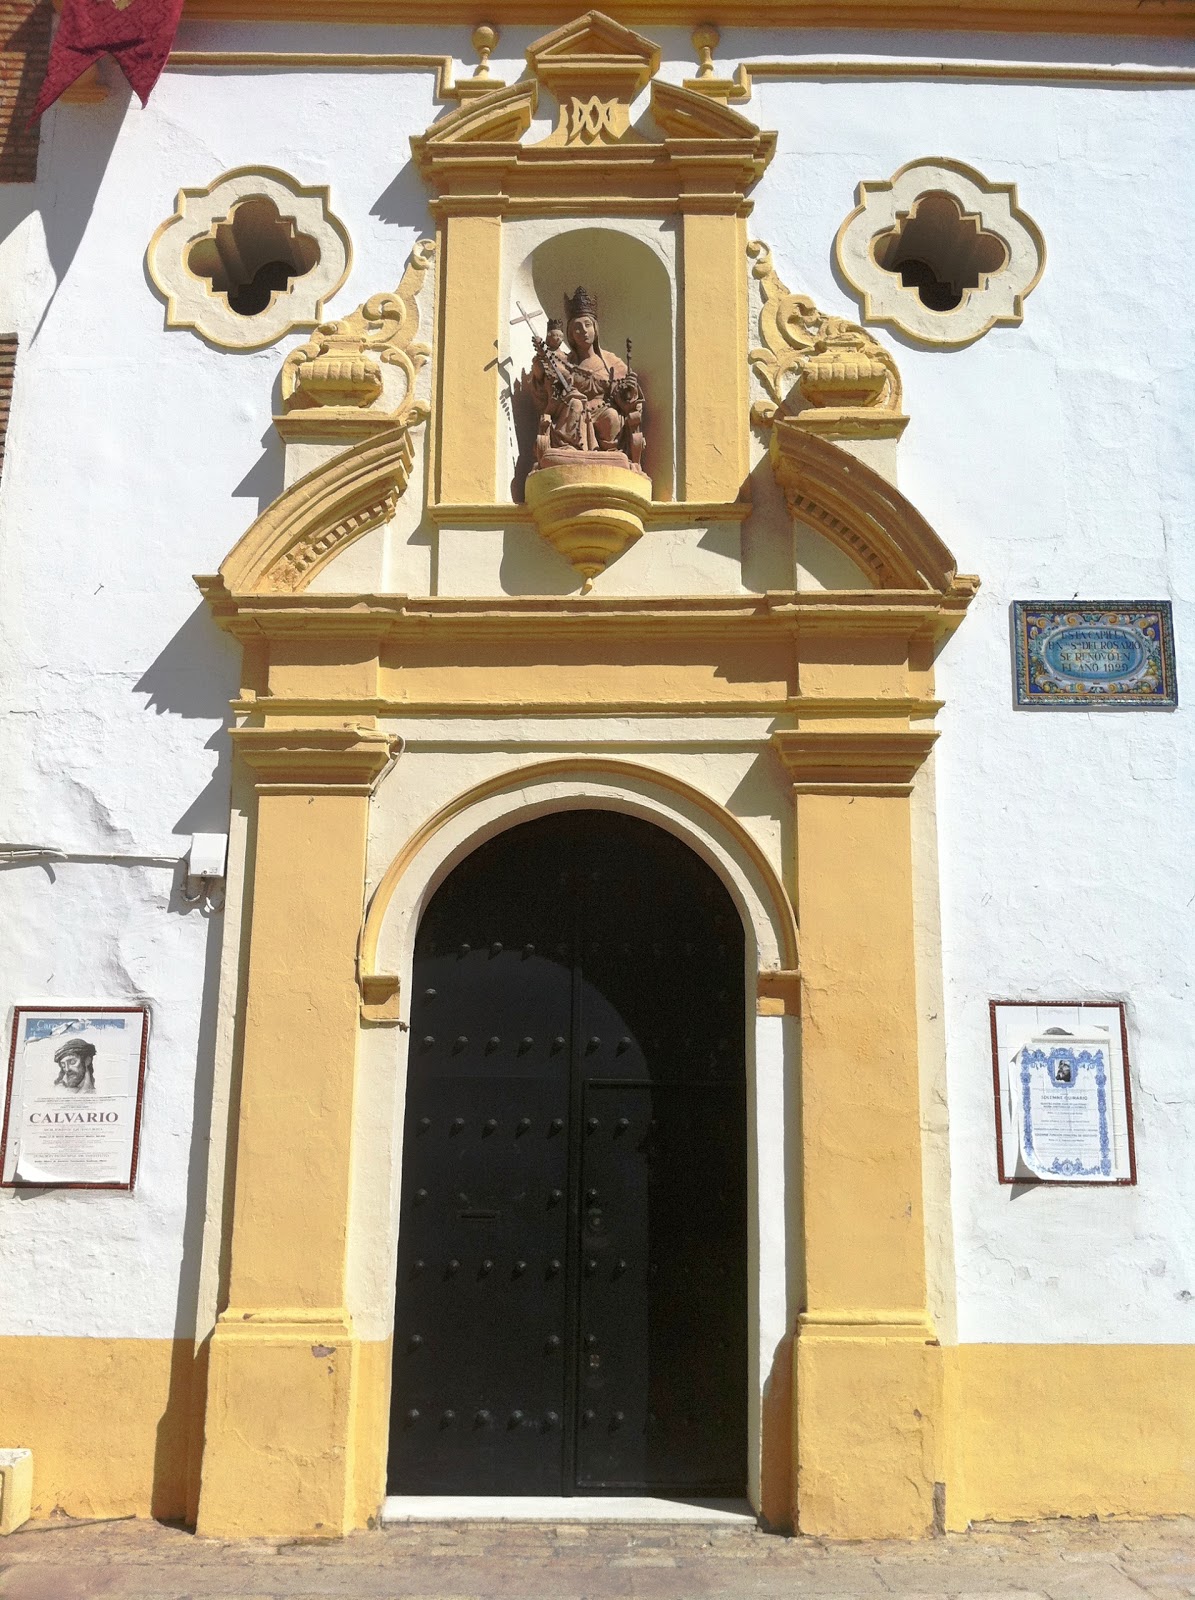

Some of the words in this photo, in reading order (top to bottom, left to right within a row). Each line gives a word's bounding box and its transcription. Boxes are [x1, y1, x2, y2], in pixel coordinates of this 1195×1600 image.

[1061, 631, 1087, 639] ESTA
[1088, 631, 1128, 639] CAPILLA
[1082, 641, 1098, 650] DEL
[1100, 641, 1141, 650] ROSARIO
[1060, 652, 1073, 661] SE
[1116, 652, 1131, 661] EN
[1062, 663, 1072, 672] EL
[1104, 663, 1129, 672] 1929
[29, 1111, 119, 1124] CALVARIO
